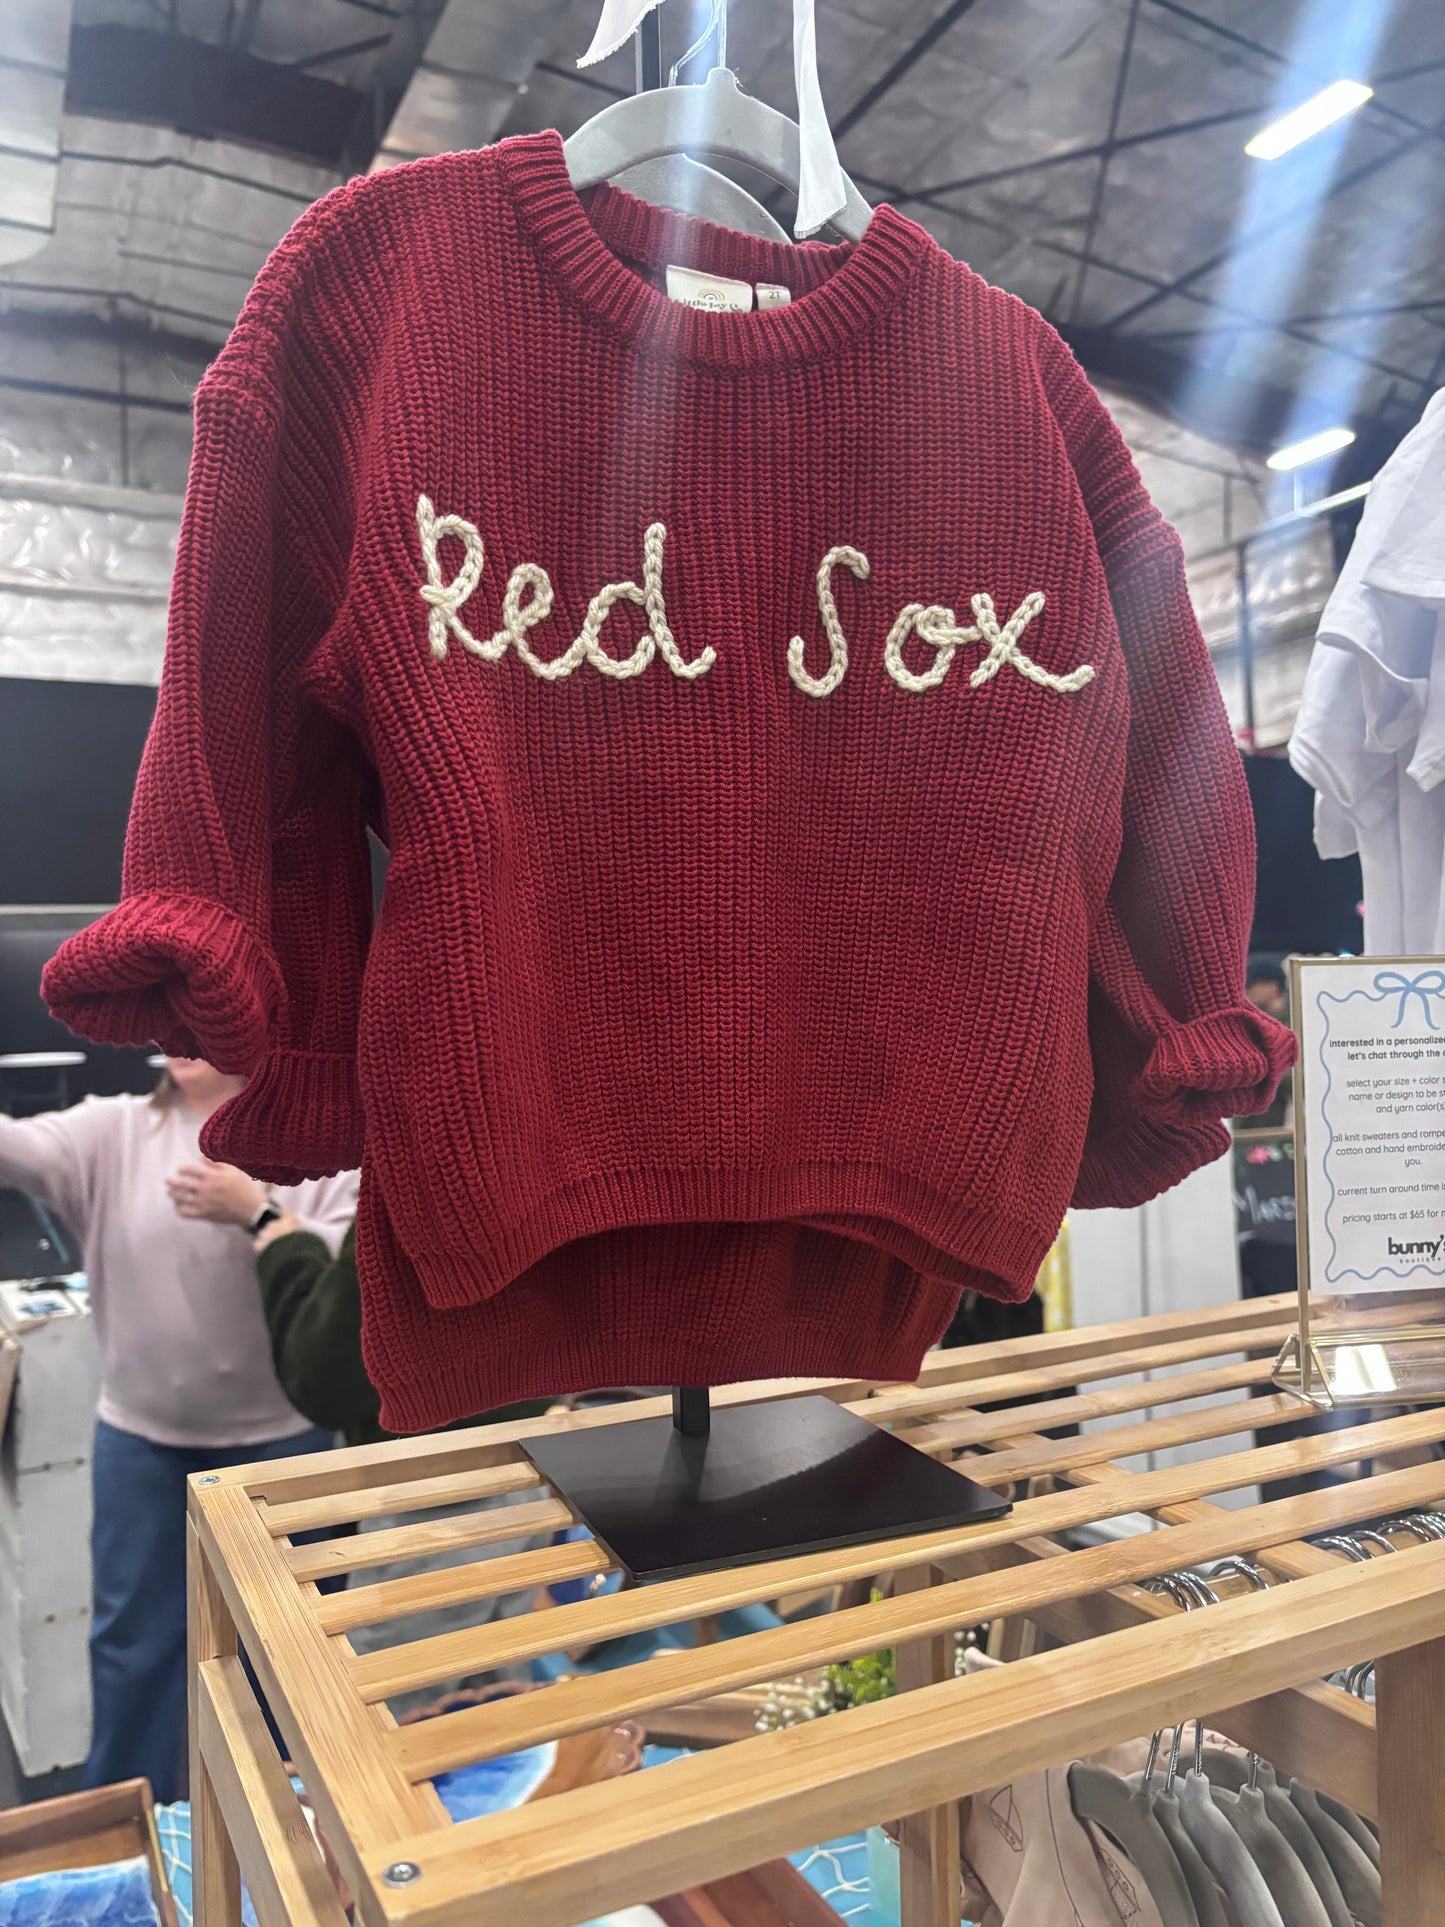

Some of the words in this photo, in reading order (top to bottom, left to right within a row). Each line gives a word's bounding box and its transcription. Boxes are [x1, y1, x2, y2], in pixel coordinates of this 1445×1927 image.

[768, 290, 781, 300] 2T
[418, 494, 717, 680] Red
[787, 545, 1095, 697] Sox
[1329, 1037, 1374, 1048] interested
[1376, 1037, 1384, 1046] in
[1386, 1038, 1392, 1046] a
[1347, 1051, 1366, 1061] let's
[1368, 1050, 1387, 1060] chat
[1390, 1049, 1424, 1060] through
[1426, 1048, 1440, 1058] the
[1346, 1077, 1371, 1088] select
[1373, 1078, 1392, 1088] your
[1394, 1077, 1410, 1086] size
[1418, 1075, 1440, 1085] color
[1348, 1093, 1373, 1101] name
[1375, 1092, 1384, 1100] or
[1386, 1089, 1414, 1101] design
[1415, 1090, 1425, 1099] to
[1427, 1089, 1438, 1098] be
[1376, 1103, 1393, 1114] and
[1394, 1104, 1414, 1115] yarn
[1333, 1133, 1342, 1143] all
[1344, 1132, 1361, 1142] knit
[1362, 1131, 1400, 1142] sweaters
[1401, 1129, 1418, 1140] and
[1335, 1146, 1364, 1156] cotton
[1364, 1144, 1382, 1155] and
[1383, 1143, 1405, 1154] hand
[1404, 1157, 1423, 1169] you.
[1337, 1187, 1368, 1197] current
[1369, 1186, 1388, 1195] turn
[1388, 1183, 1419, 1194] around
[1421, 1182, 1440, 1192] time
[1342, 1213, 1371, 1225] pricing
[1372, 1212, 1397, 1222] starts
[1398, 1211, 1408, 1221] at
[1410, 1209, 1425, 1220] $65
[1427, 1208, 1439, 1219] for
